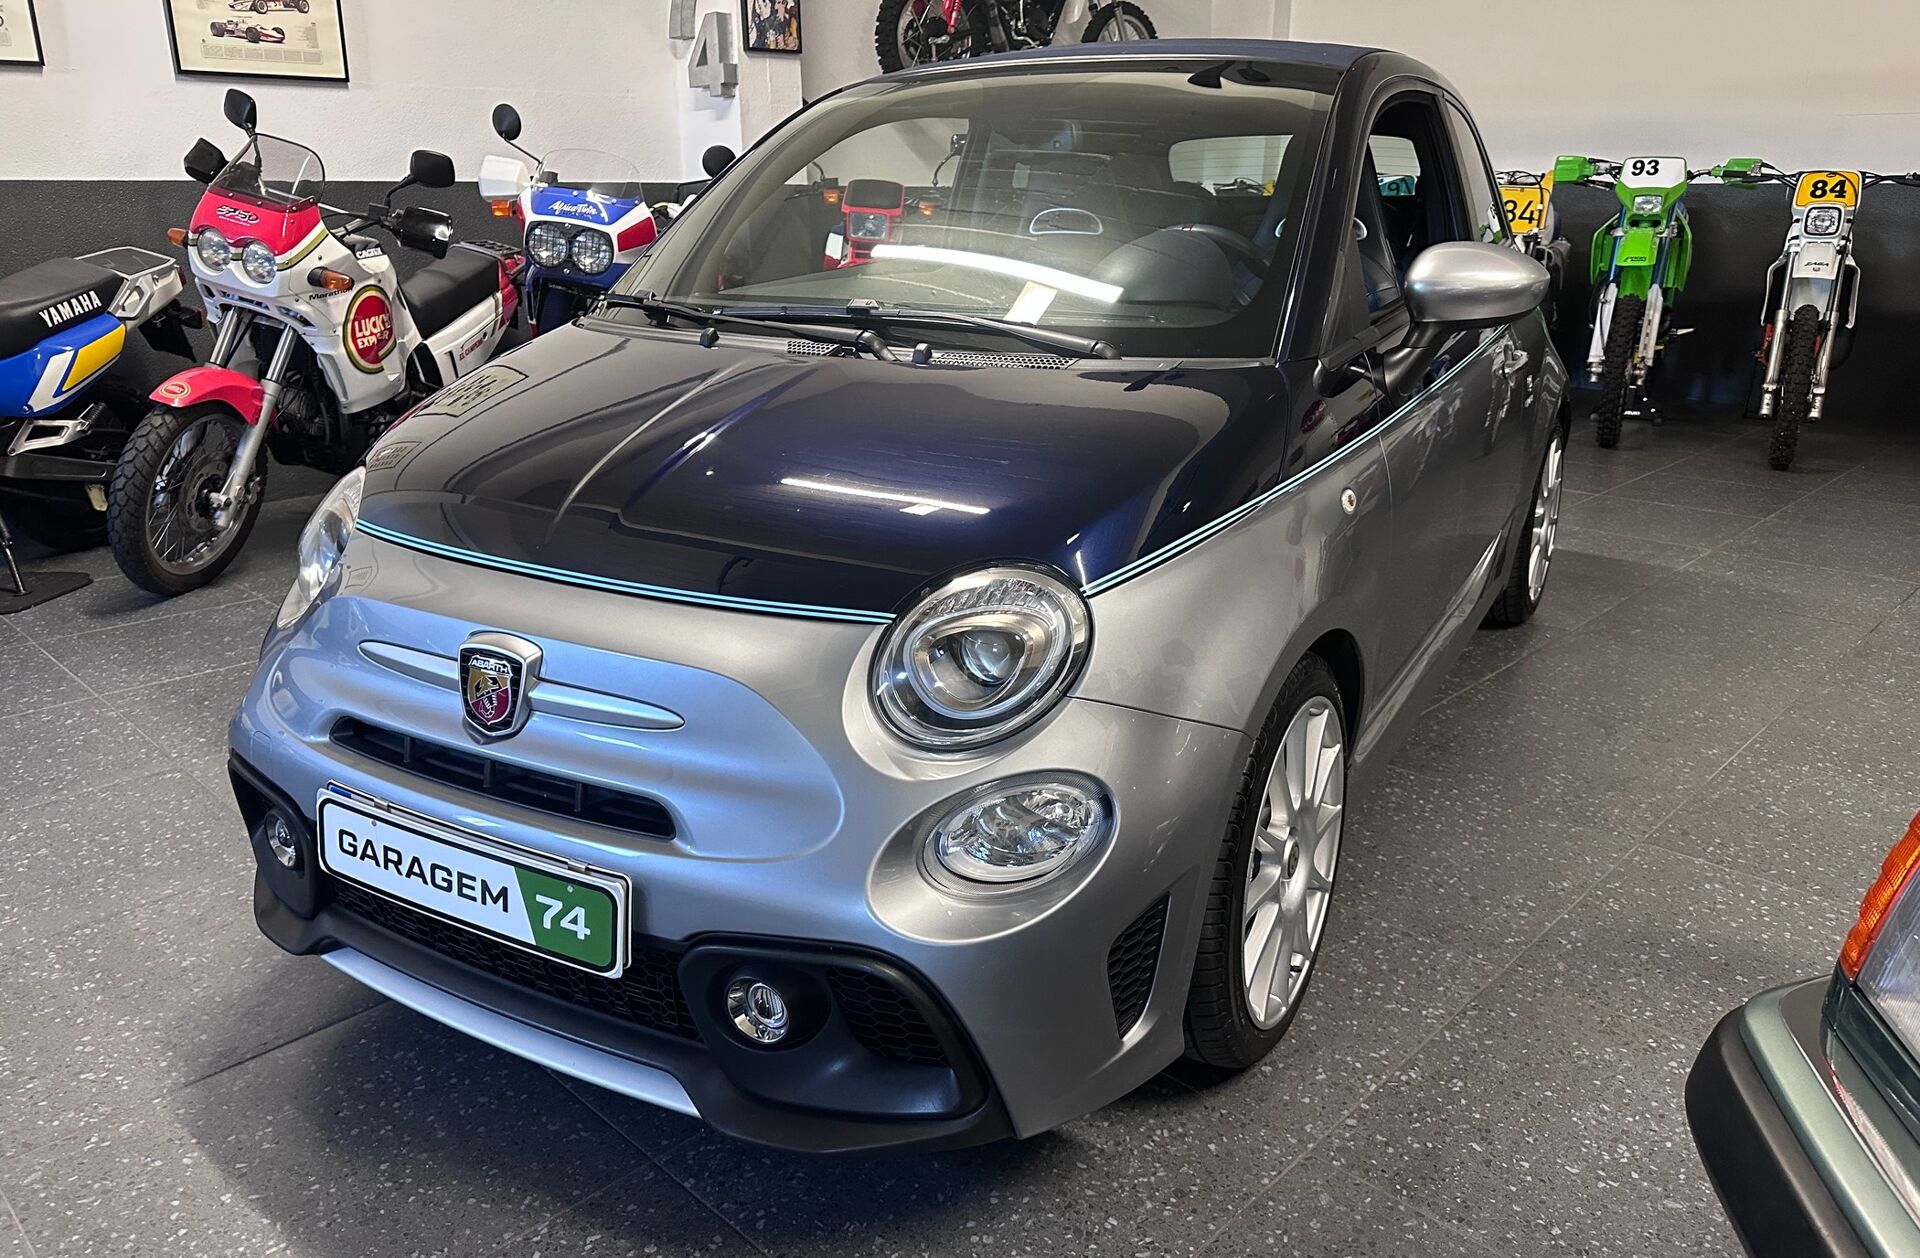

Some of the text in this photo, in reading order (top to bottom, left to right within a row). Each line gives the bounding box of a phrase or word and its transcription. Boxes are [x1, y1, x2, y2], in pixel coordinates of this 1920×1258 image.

[669, 0, 738, 97] 4
[1631, 159, 1660, 176] 93
[1809, 179, 1847, 198] 84
[1504, 199, 1538, 224] 84
[38, 290, 102, 328] YAMAHA
[471, 658, 508, 673] ABARTH
[338, 828, 591, 940] GARAGEM 74
